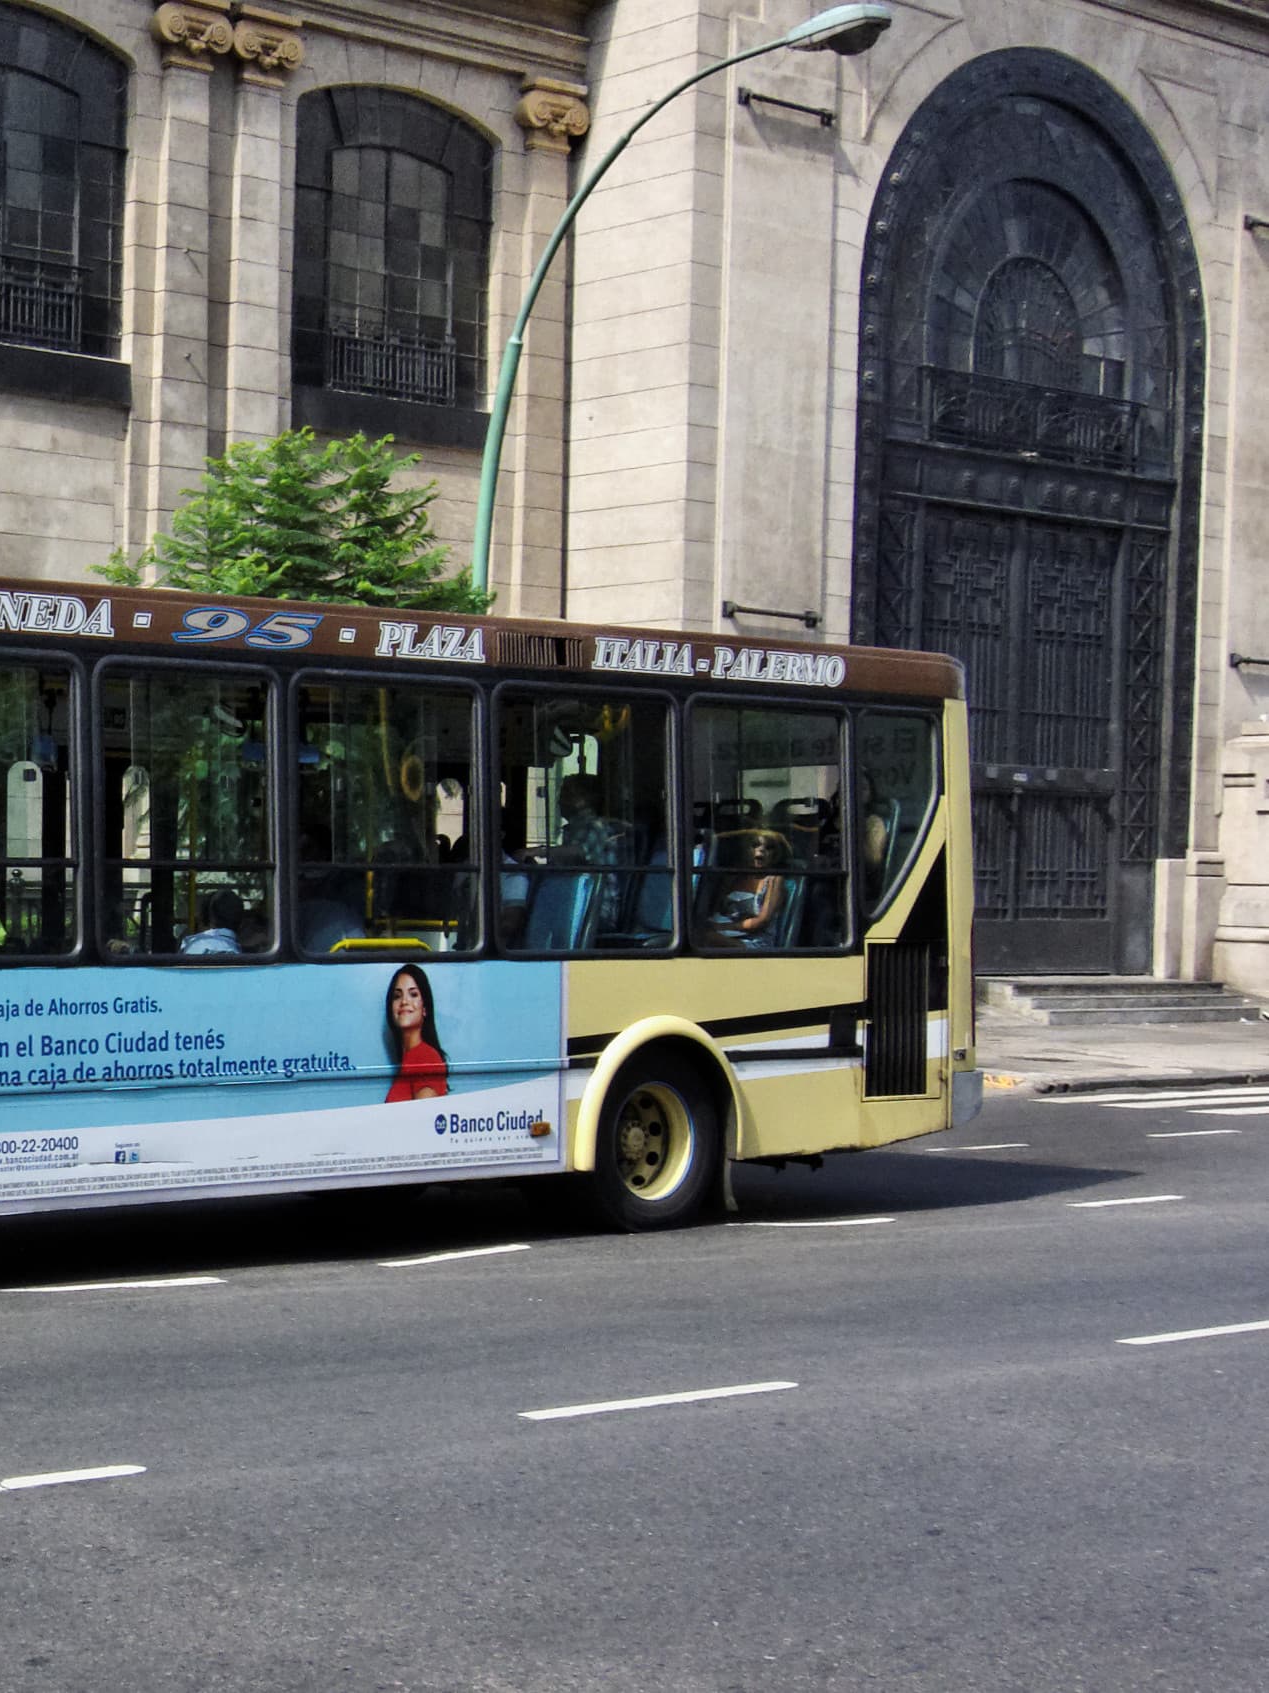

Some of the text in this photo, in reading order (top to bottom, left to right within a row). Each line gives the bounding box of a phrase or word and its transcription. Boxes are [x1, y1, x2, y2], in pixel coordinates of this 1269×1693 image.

[171, 606, 325, 650] 95
[375, 621, 486, 664] PLAZA
[591, 637, 694, 677] ITALIA
[710, 646, 846, 688] PALERMO
[25, 999, 44, 1017] de
[48, 998, 109, 1016] Ahorros
[113, 996, 163, 1014] Gratis.
[16, 1034, 34, 1057] el
[41, 1035, 99, 1056] Banco
[105, 1030, 169, 1054] Ciudad
[175, 1028, 225, 1050] tenés
[27, 1063, 67, 1089] caja
[73, 1061, 96, 1083] de
[102, 1060, 173, 1081] ahorros
[179, 1056, 277, 1078] totalmente
[450, 1113, 494, 1134] Banco
